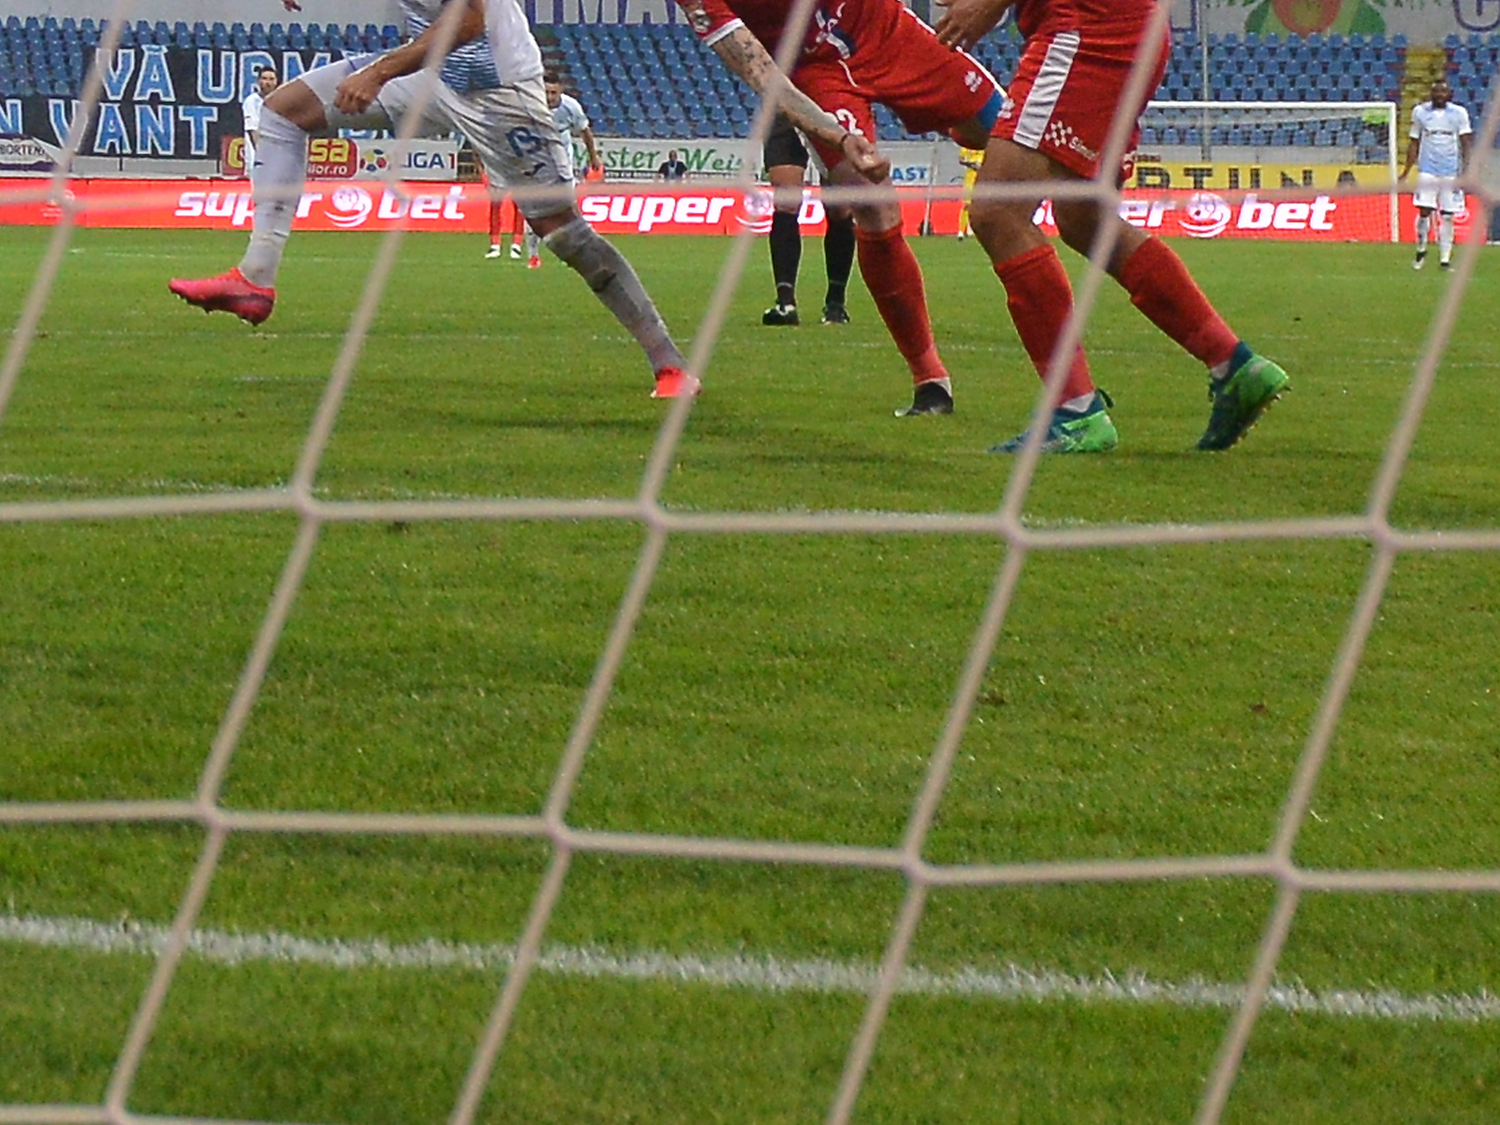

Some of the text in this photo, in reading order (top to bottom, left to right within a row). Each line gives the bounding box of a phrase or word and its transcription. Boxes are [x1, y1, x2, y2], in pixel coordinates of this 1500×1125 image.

[48, 97, 218, 156] VANT
[678, 147, 745, 172] Weis
[174, 183, 466, 226] supr bet
[581, 194, 736, 233] super
[1236, 193, 1337, 231] bet
